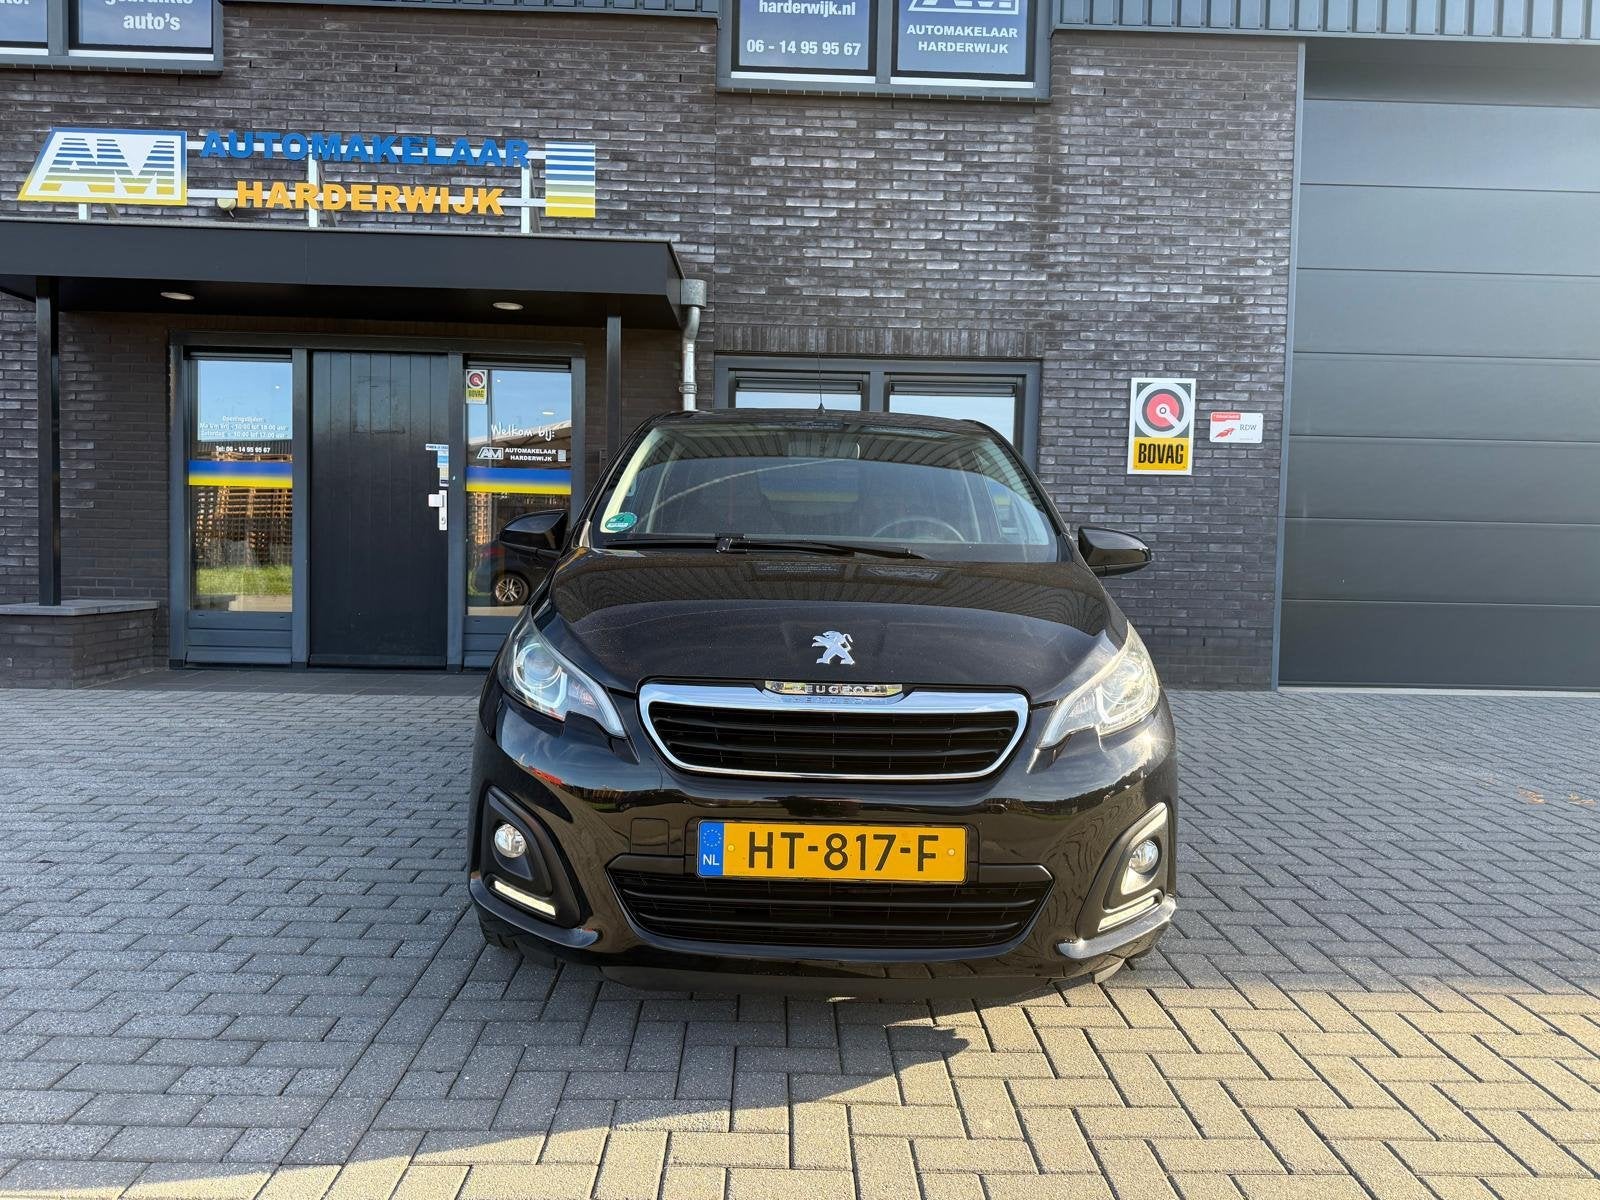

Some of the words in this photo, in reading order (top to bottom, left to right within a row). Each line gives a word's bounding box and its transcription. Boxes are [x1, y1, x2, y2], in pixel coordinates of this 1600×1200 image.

[759, 0, 856, 17] harderwijk.nl
[123, 12, 181, 31] auto's
[906, 24, 1018, 38] AUTOMAKELAAR
[746, 39, 765, 53] 06
[779, 40, 797, 54] 14
[800, 41, 818, 54] 95
[822, 41, 840, 55] 95
[843, 42, 861, 56] 67
[918, 41, 1009, 54] HARDERWIJK
[200, 130, 531, 168] AUTOMAKELAAR
[39, 136, 175, 195] AM
[235, 180, 505, 216] HARDERWIJK
[491, 422, 533, 437] Welkom
[505, 447, 557, 455] AUTOMAKELAAR
[510, 454, 553, 462] HARDERWIJK
[1138, 443, 1184, 464] BOVAG
[748, 830, 939, 872] HT-817-F
[702, 854, 720, 867] NL
